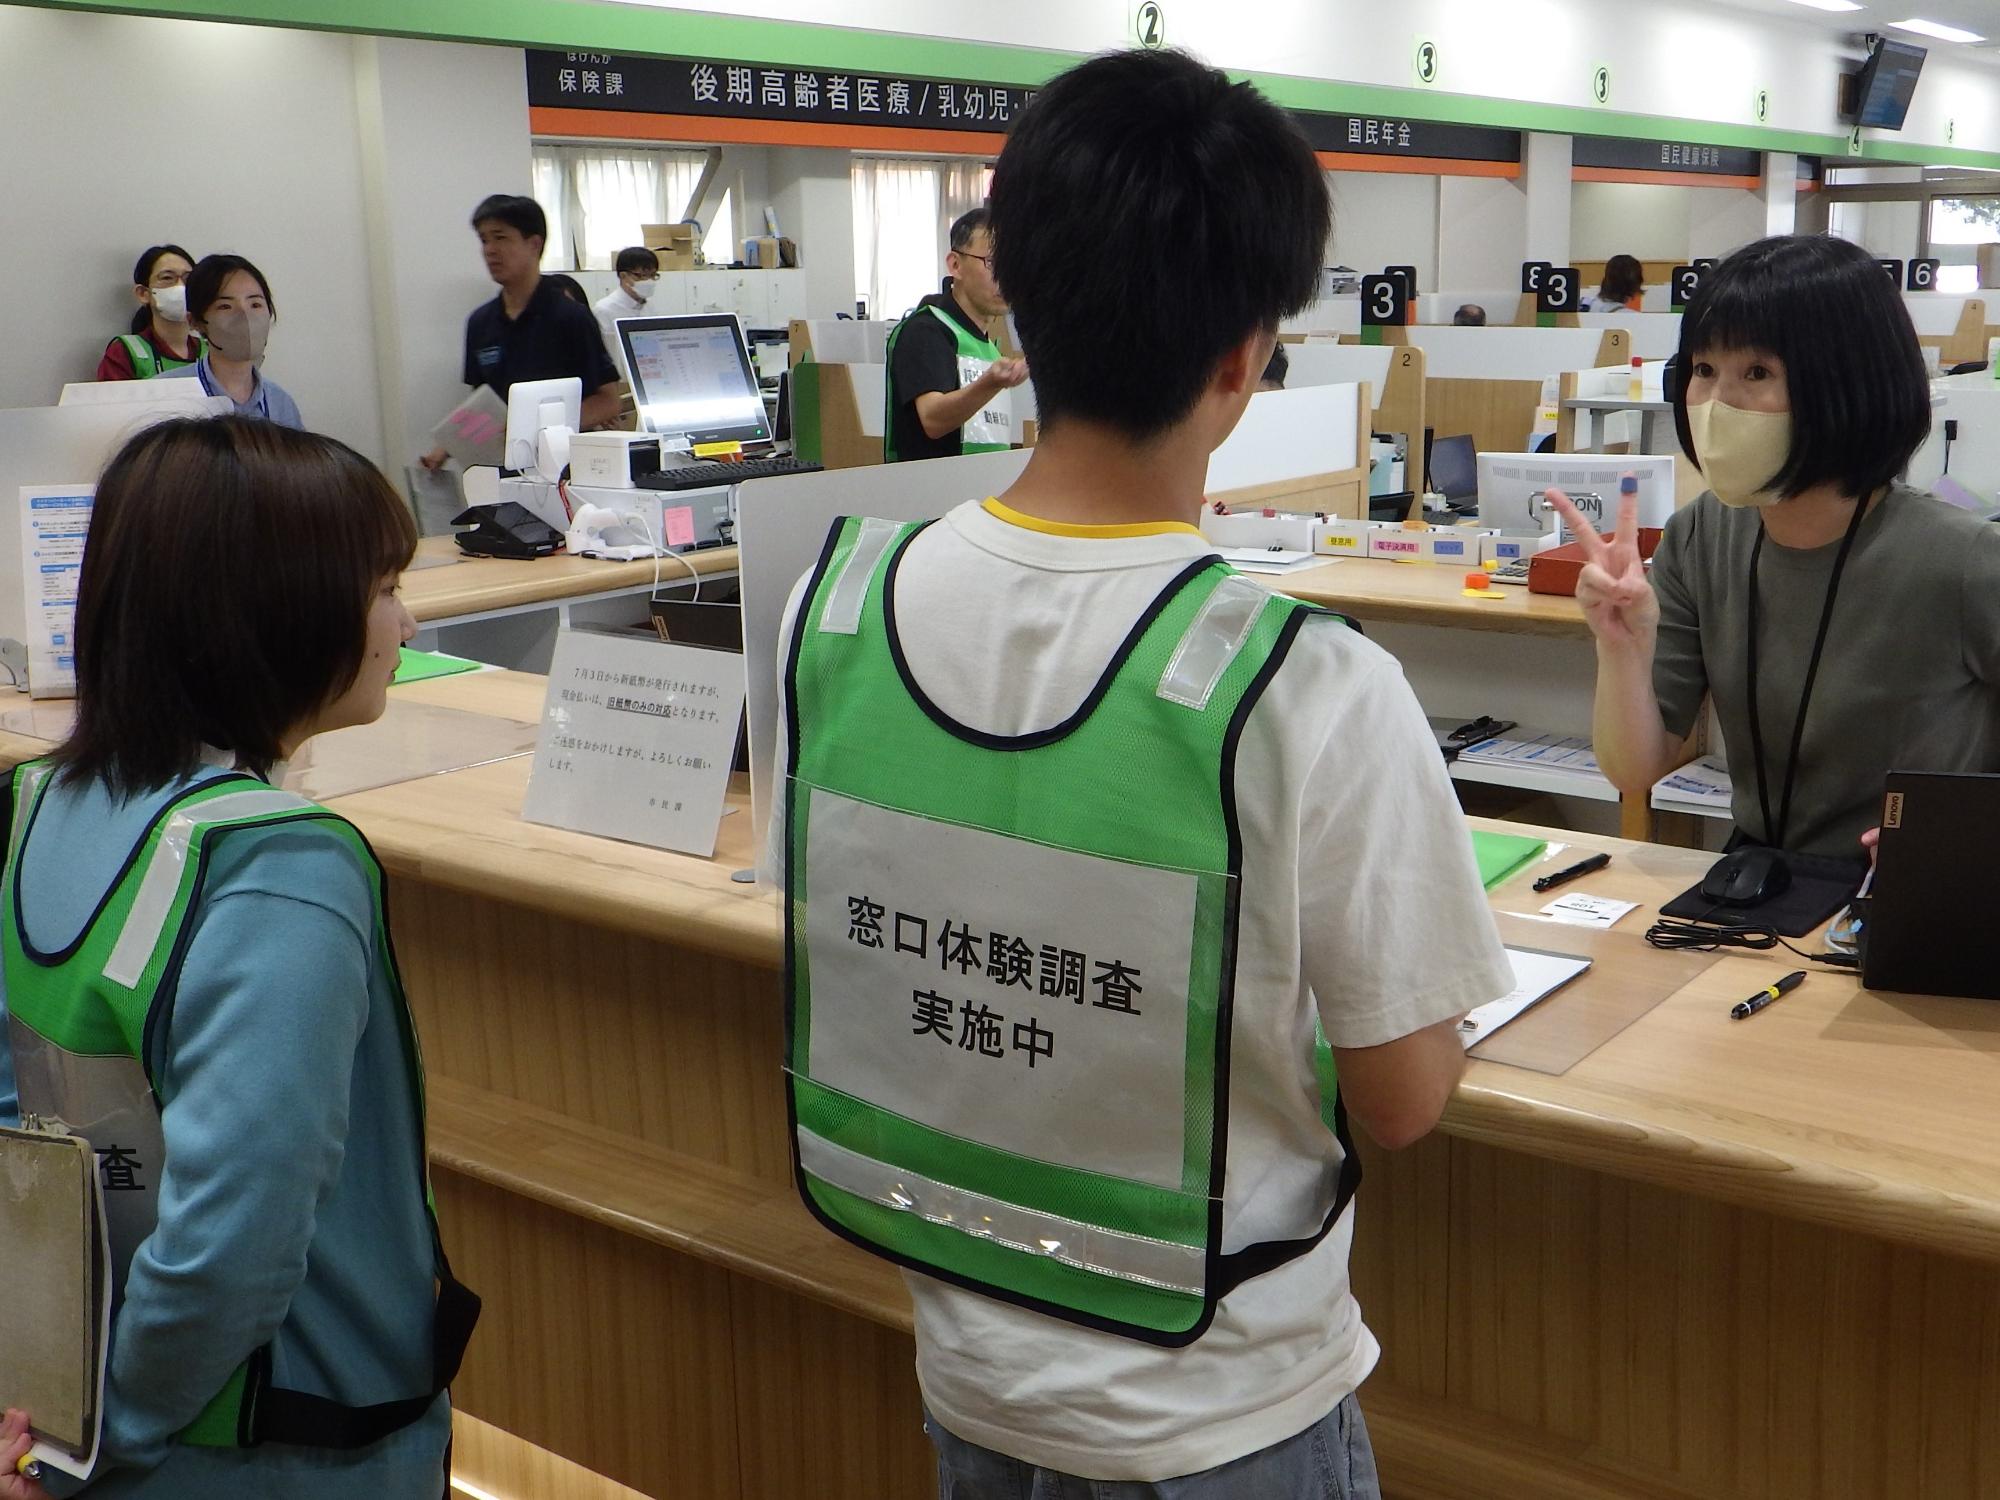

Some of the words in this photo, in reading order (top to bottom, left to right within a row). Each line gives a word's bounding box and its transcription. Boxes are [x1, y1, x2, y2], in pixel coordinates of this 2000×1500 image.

[558, 68, 624, 96] 保険課
[1348, 118, 1411, 147] 国民年金
[1915, 263, 1931, 285] 6
[1372, 282, 1395, 319] 3
[1547, 274, 1568, 306] 3
[1611, 334, 1620, 346] 3
[1402, 353, 1412, 367] 2
[1887, 796, 1899, 825] Lenovo
[847, 895, 1144, 1016] 窓口体験調査
[911, 989, 1055, 1068] 実施中
[95, 1144, 146, 1190] 査
